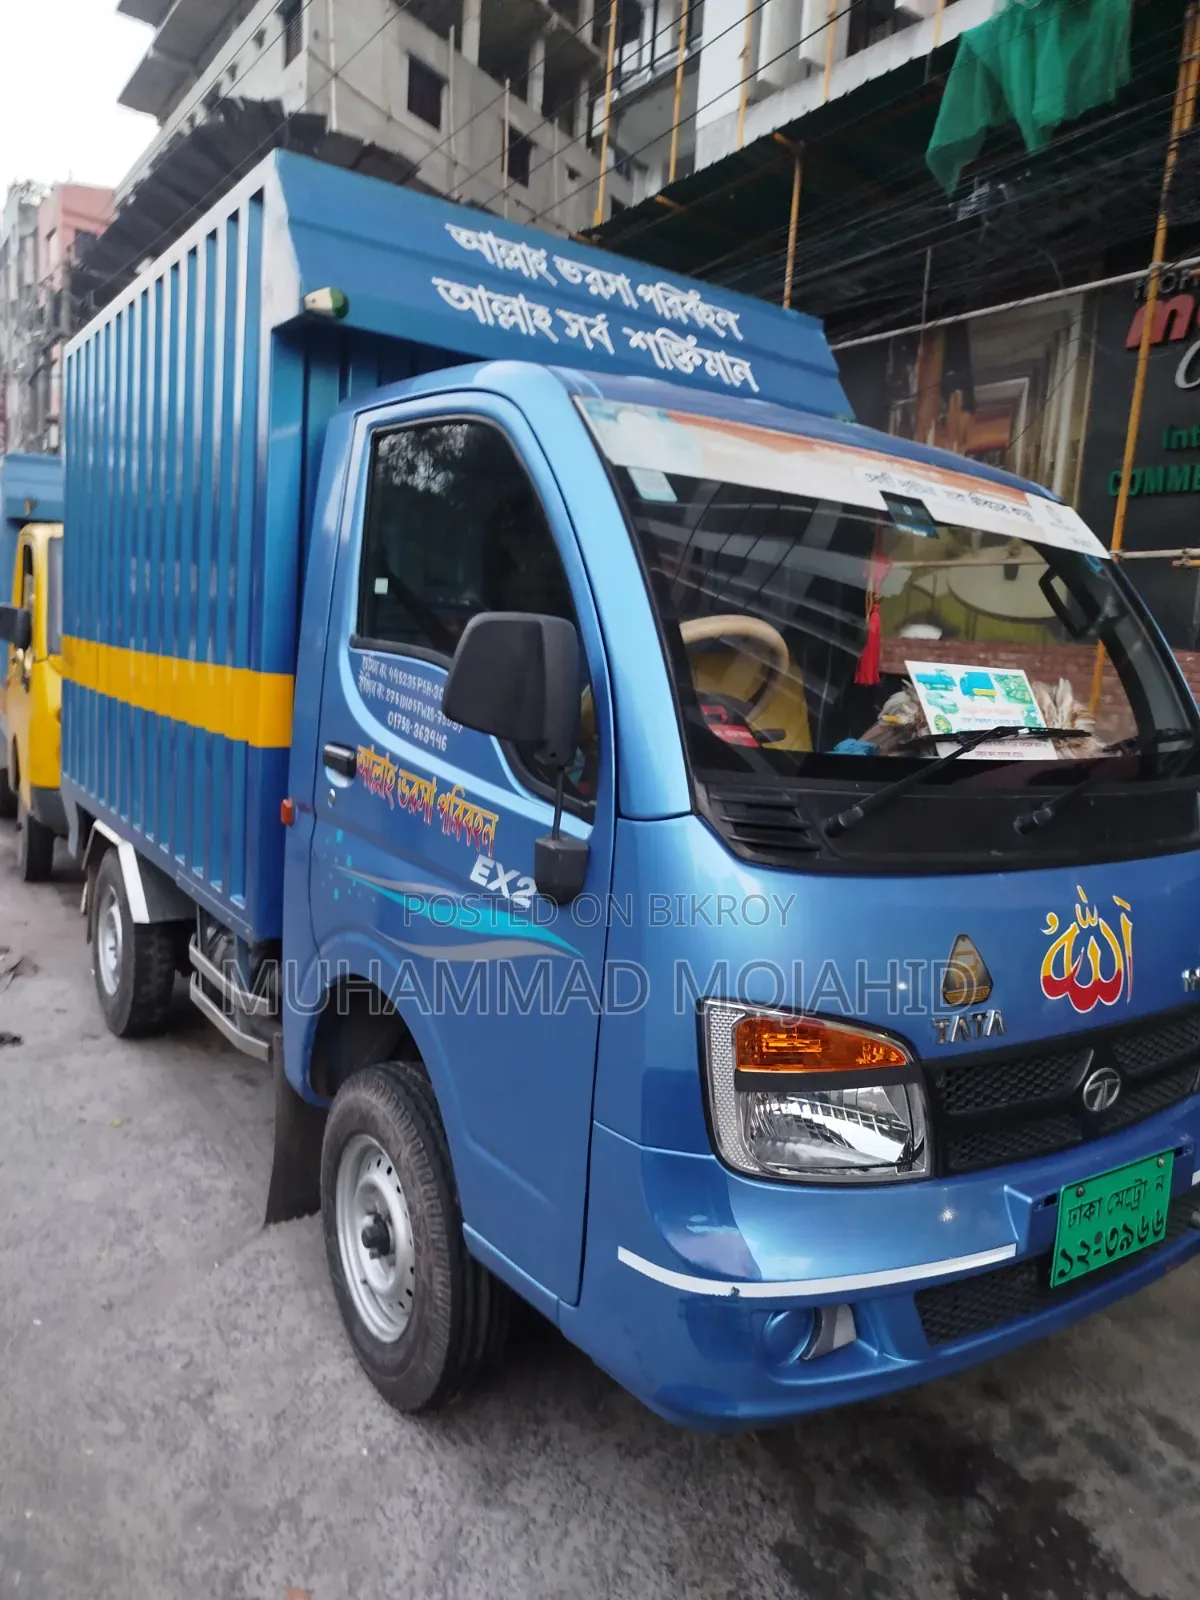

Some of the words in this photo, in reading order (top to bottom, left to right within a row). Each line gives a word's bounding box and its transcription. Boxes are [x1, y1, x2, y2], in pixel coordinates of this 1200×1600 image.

[444, 222, 559, 287] আল্লাহ
[431, 276, 560, 344] আল্লাহ
[356, 743, 399, 810] আল্লাহ
[397, 767, 438, 824] ভরসা
[437, 784, 499, 856] পরিবহন
[469, 854, 538, 908] EX2
[932, 1009, 1006, 1044] TATA
[1057, 1209, 1165, 1278] ১২-৩৯৬৬
[1067, 1196, 1103, 1229] ঢাকা
